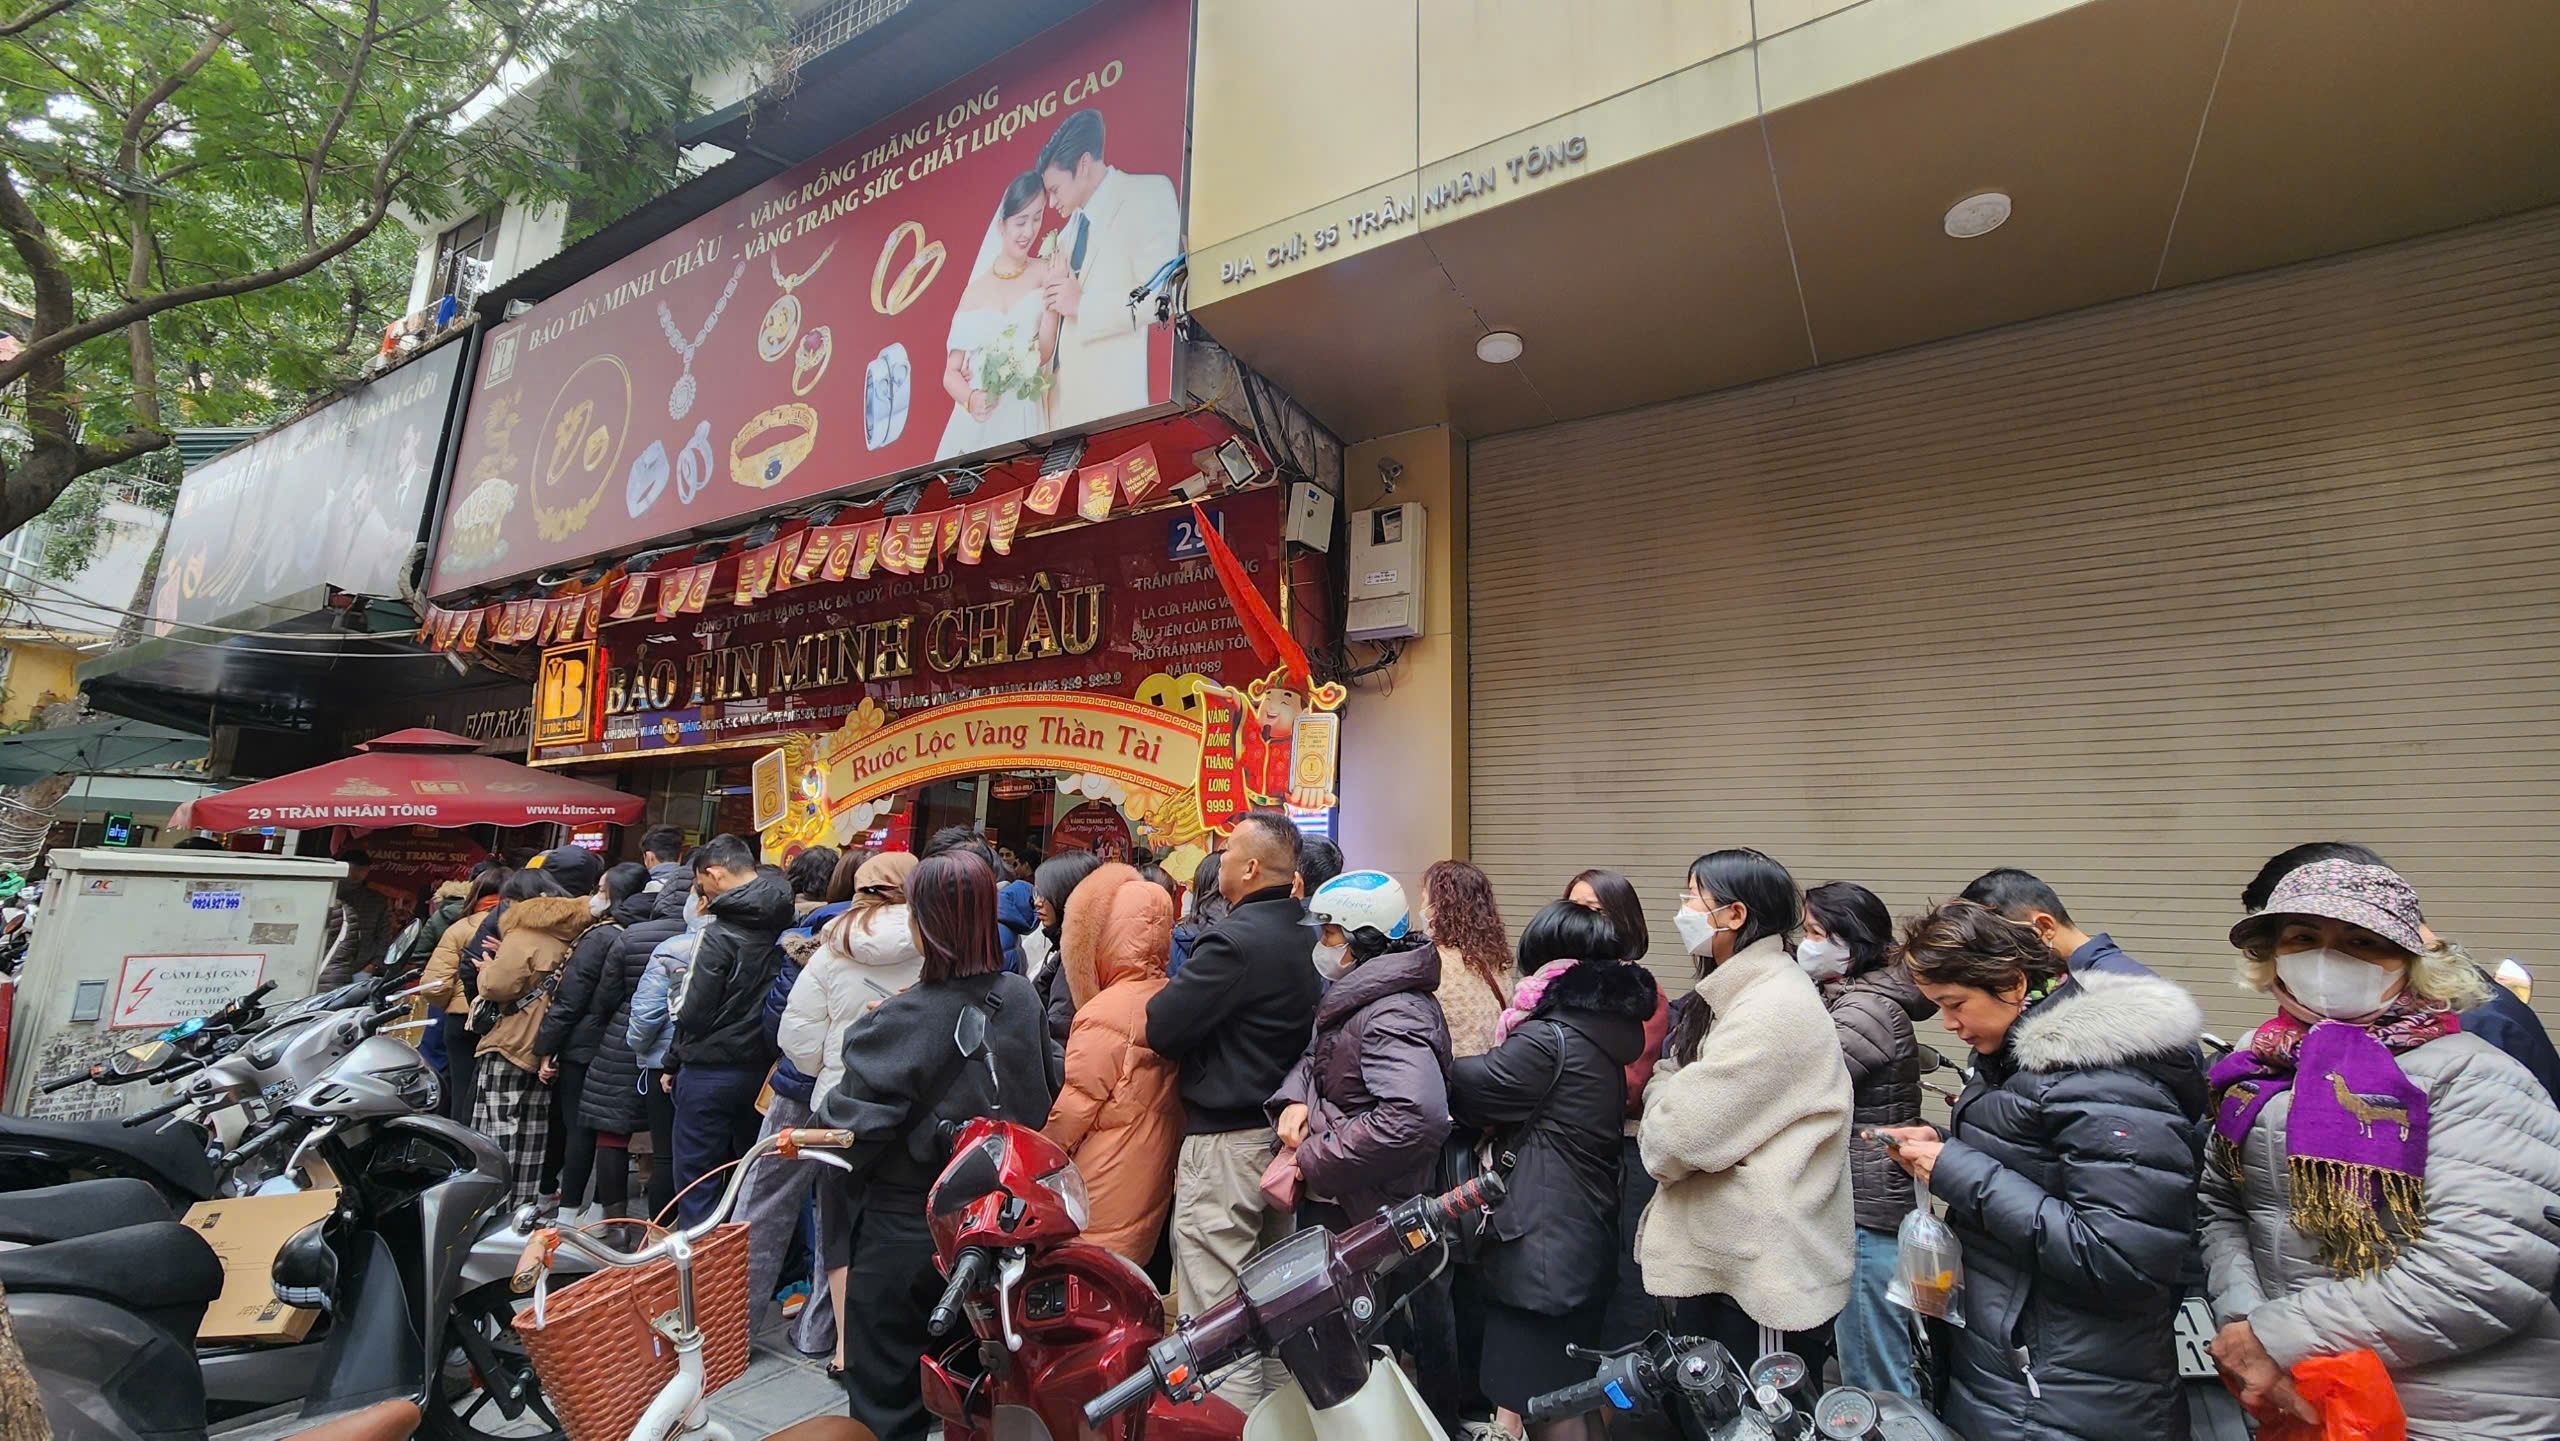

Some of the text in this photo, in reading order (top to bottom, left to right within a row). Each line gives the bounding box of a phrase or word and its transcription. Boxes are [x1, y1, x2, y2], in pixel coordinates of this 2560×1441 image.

[745, 222, 792, 260] VÀNG
[796, 189, 859, 236] TRANG
[862, 166, 904, 205] SỨC
[908, 131, 968, 181] CHẤT
[971, 90, 1057, 153] LƯỢNG
[1063, 59, 1123, 106] CAO
[750, 190, 797, 230] VÀNG
[861, 121, 930, 174] THĂNG
[935, 85, 999, 136] LONG
[1219, 255, 1256, 283] ĐỊA
[1313, 223, 1339, 251] 35
[1347, 195, 1415, 239] TRẦN
[1423, 166, 1497, 214] NHÂN
[1505, 135, 1588, 183] TÔNG
[528, 235, 723, 351] BẢO TÍN MINH CHÂU
[726, 614, 739, 628] TY
[604, 572, 1105, 714] BẢO TÍN MINH CHÂU
[1190, 638, 1224, 654] NHÂN
[1227, 633, 1252, 650] TÔN
[1195, 660, 1222, 674] 1989
[1207, 706, 1230, 724] VÀNG
[852, 716, 1164, 780] Rước Lộc Vàng Thần Tài
[1204, 754, 1234, 770] THĂNG
[1207, 778, 1231, 792] LONG
[247, 803, 438, 820] 29 TRẦN NHÂN TÔNG
[526, 804, 616, 815] www.btmc.vn
[1206, 799, 1234, 812] 999.9
[108, 823, 127, 837] aha
